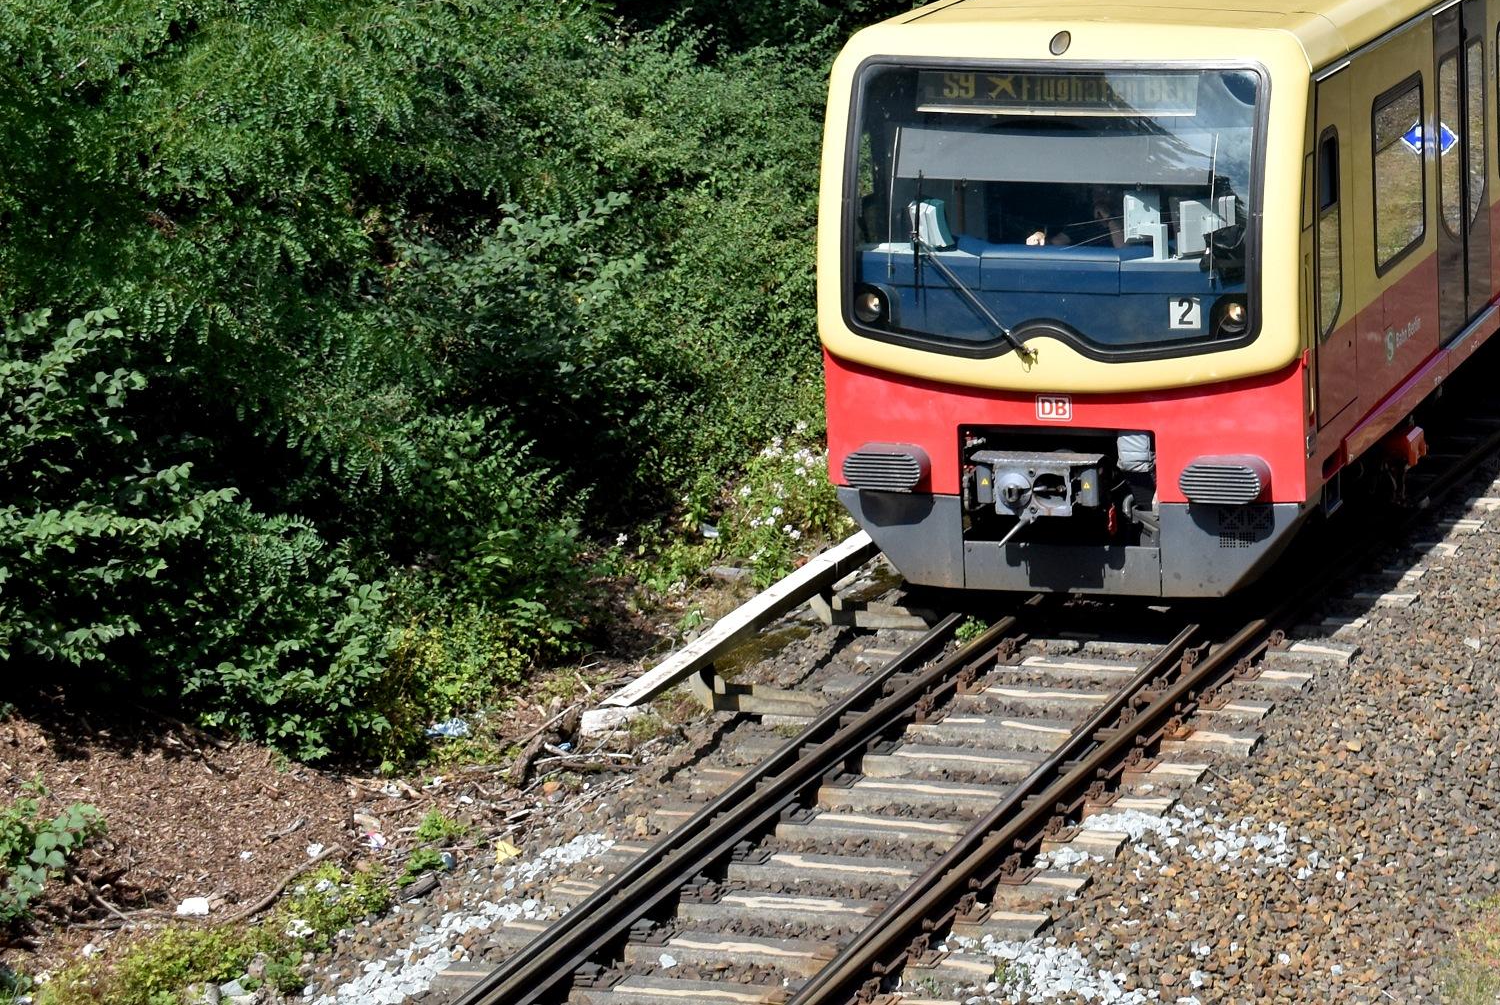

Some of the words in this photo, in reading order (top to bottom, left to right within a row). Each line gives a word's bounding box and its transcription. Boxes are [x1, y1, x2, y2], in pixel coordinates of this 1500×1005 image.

[943, 72, 976, 99] S9
[1178, 298, 1194, 325] 2
[1040, 398, 1068, 416] DB
